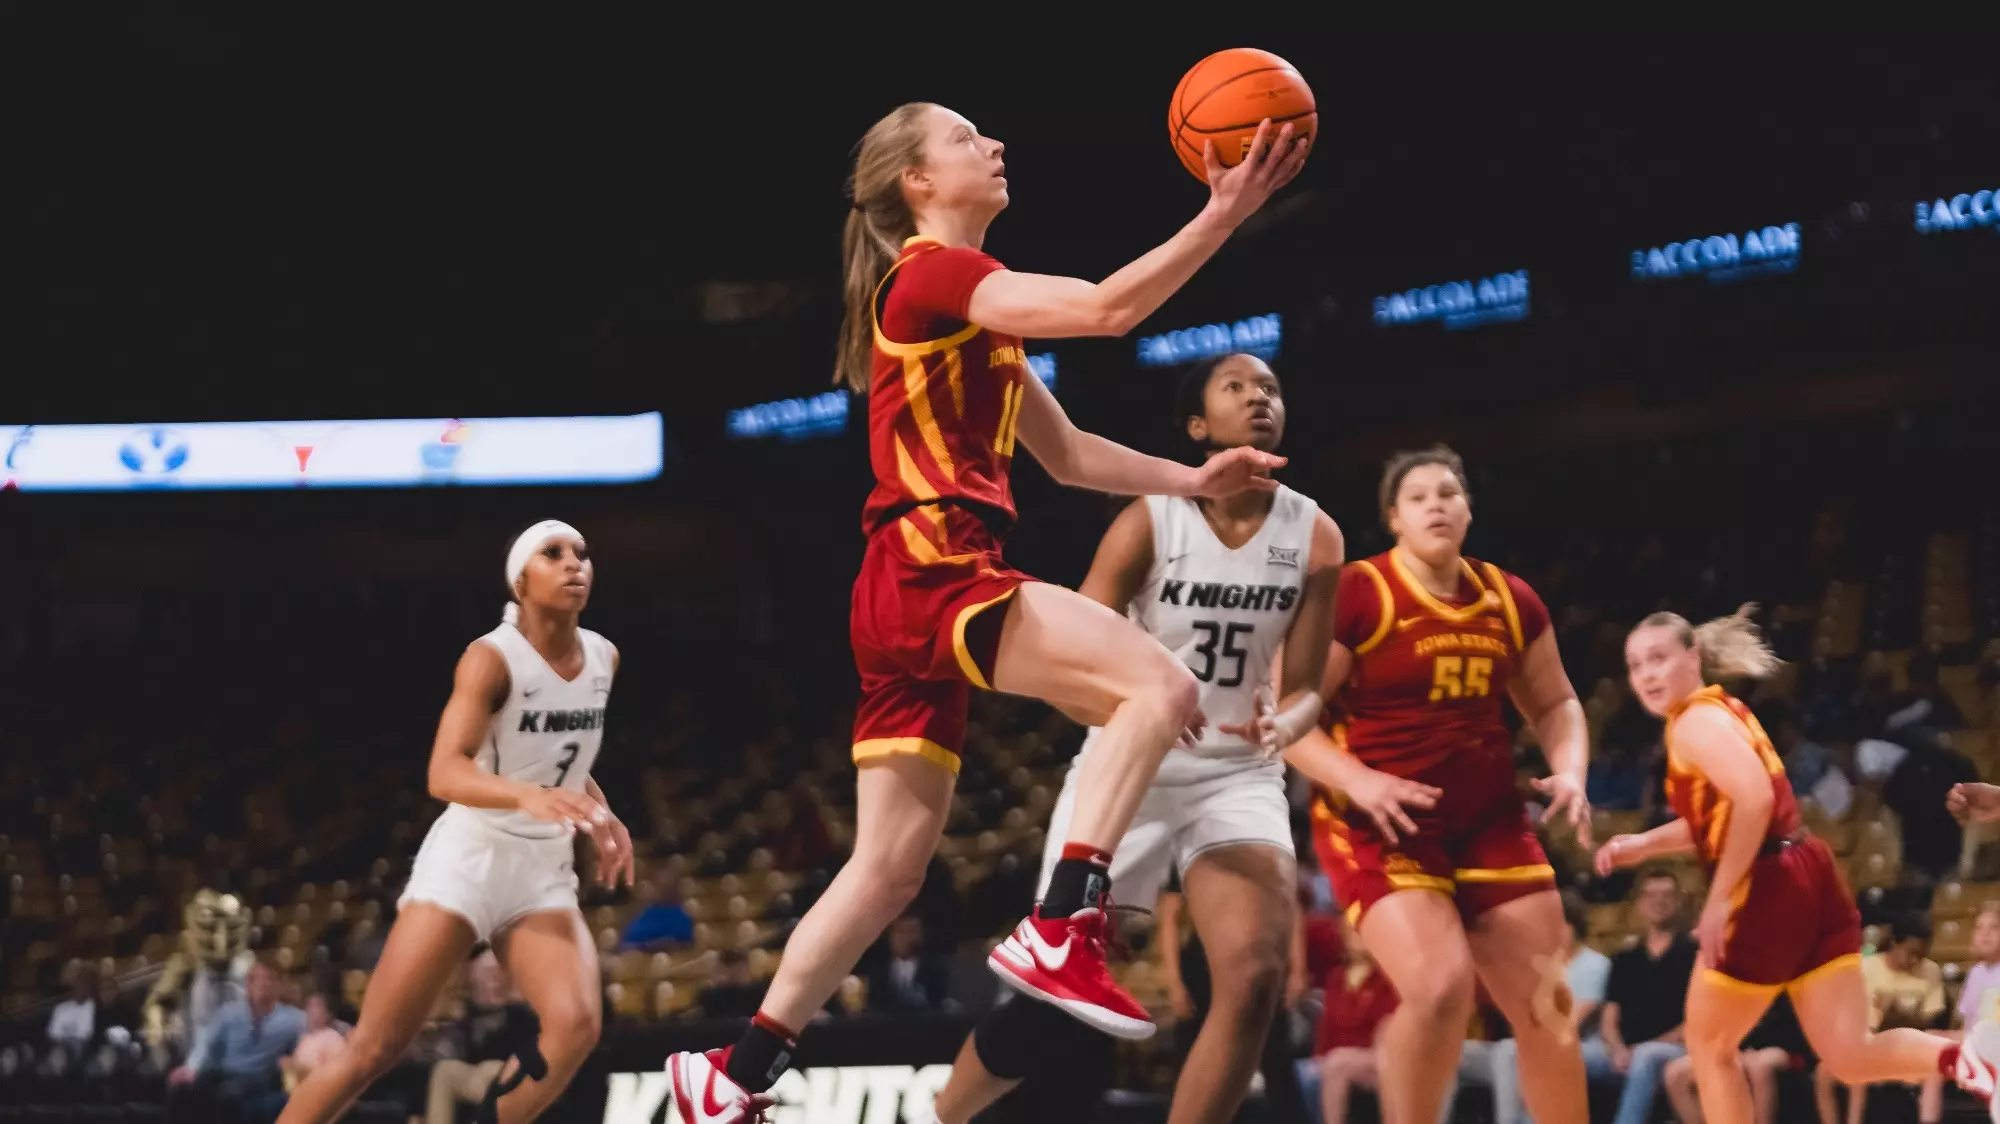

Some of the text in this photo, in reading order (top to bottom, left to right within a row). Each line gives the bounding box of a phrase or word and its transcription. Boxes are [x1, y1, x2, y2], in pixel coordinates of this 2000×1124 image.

[1930, 187, 2000, 230] ACC
[1159, 578, 1300, 611] KNIGHTS
[1189, 620, 1255, 687] 35
[1429, 656, 1493, 701] 55
[518, 708, 605, 732] KNIGHT
